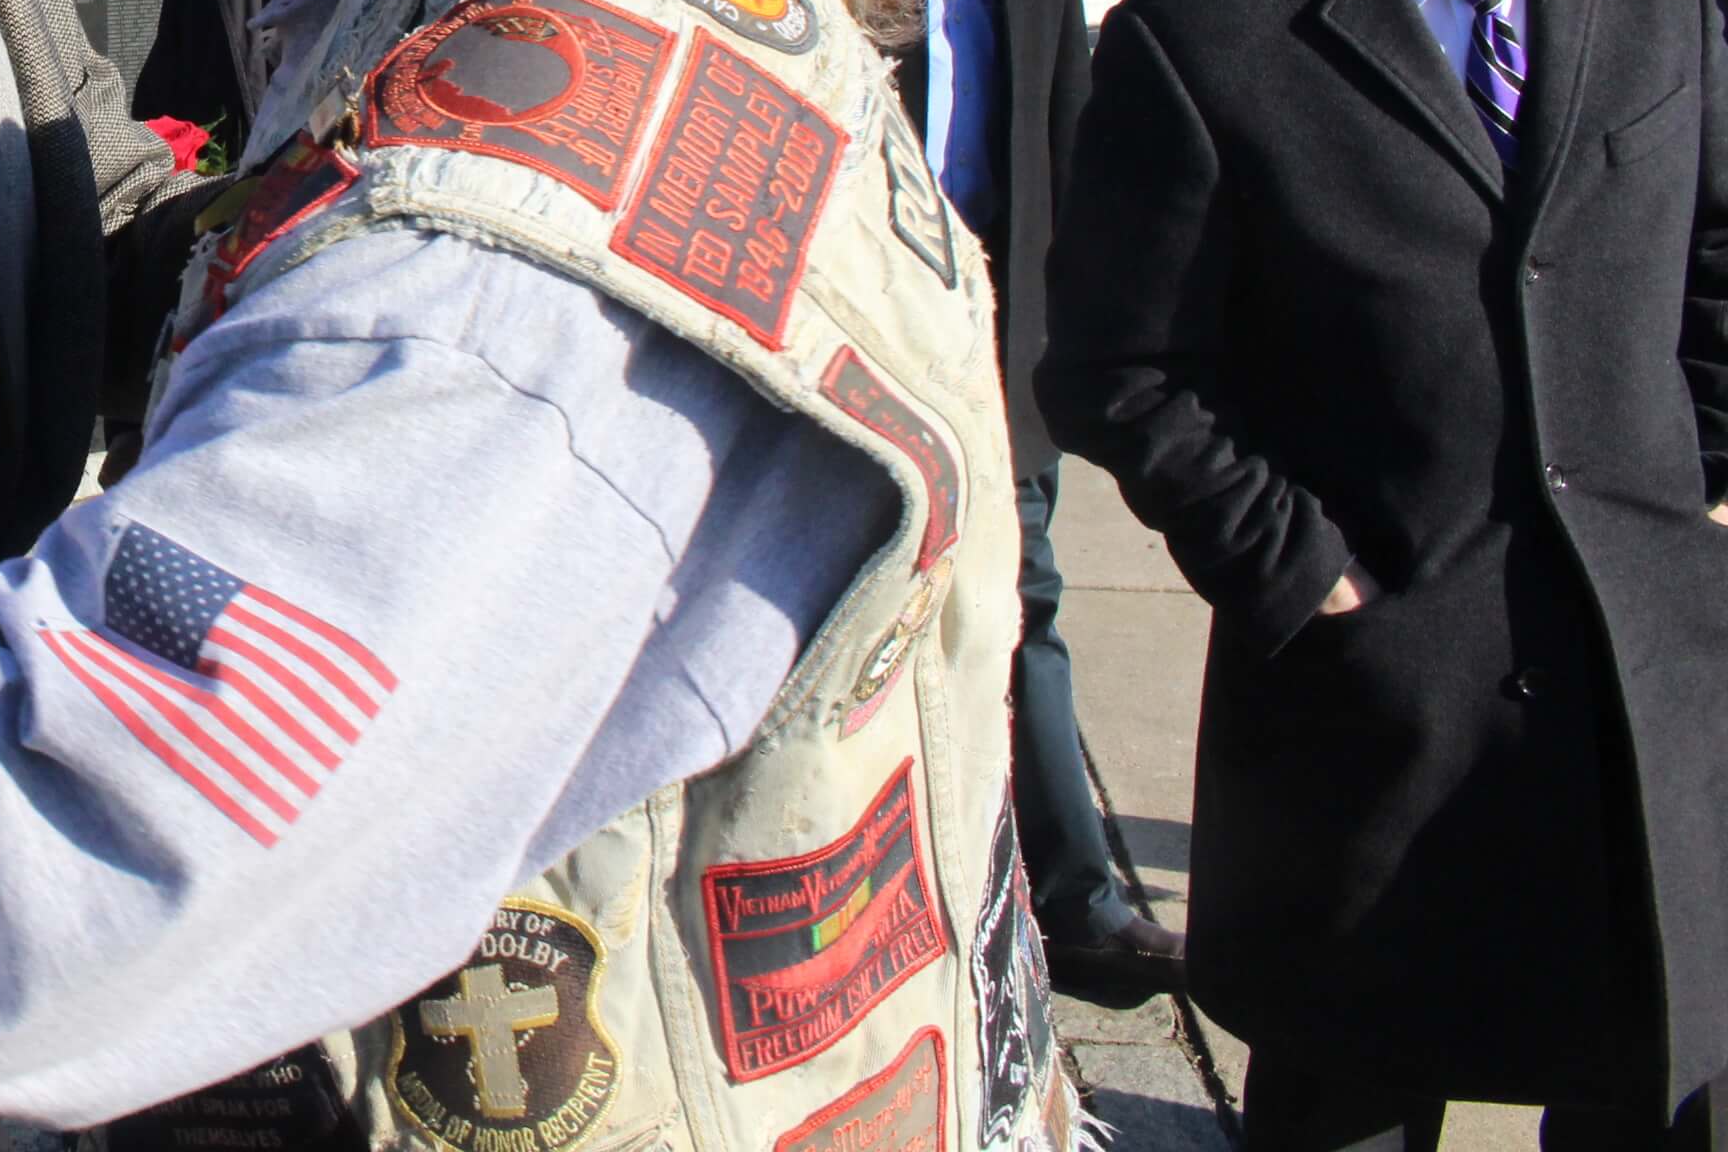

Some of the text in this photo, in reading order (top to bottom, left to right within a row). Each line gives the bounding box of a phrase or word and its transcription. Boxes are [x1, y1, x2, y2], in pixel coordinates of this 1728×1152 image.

[593, 56, 648, 147] MEMORY
[634, 50, 746, 266] IN MEMORY OF
[704, 79, 790, 233] SAMPLEY
[681, 228, 733, 288] TED
[735, 121, 824, 304] 1946-2009
[480, 932, 569, 974] DOLBY
[525, 914, 557, 936] OF
[738, 1005, 844, 1072] FREEDOM
[888, 917, 937, 973] FREE
[444, 1114, 473, 1144] OF
[473, 1125, 540, 1152] HONOR
[537, 1051, 614, 1148] RECIPIENT
